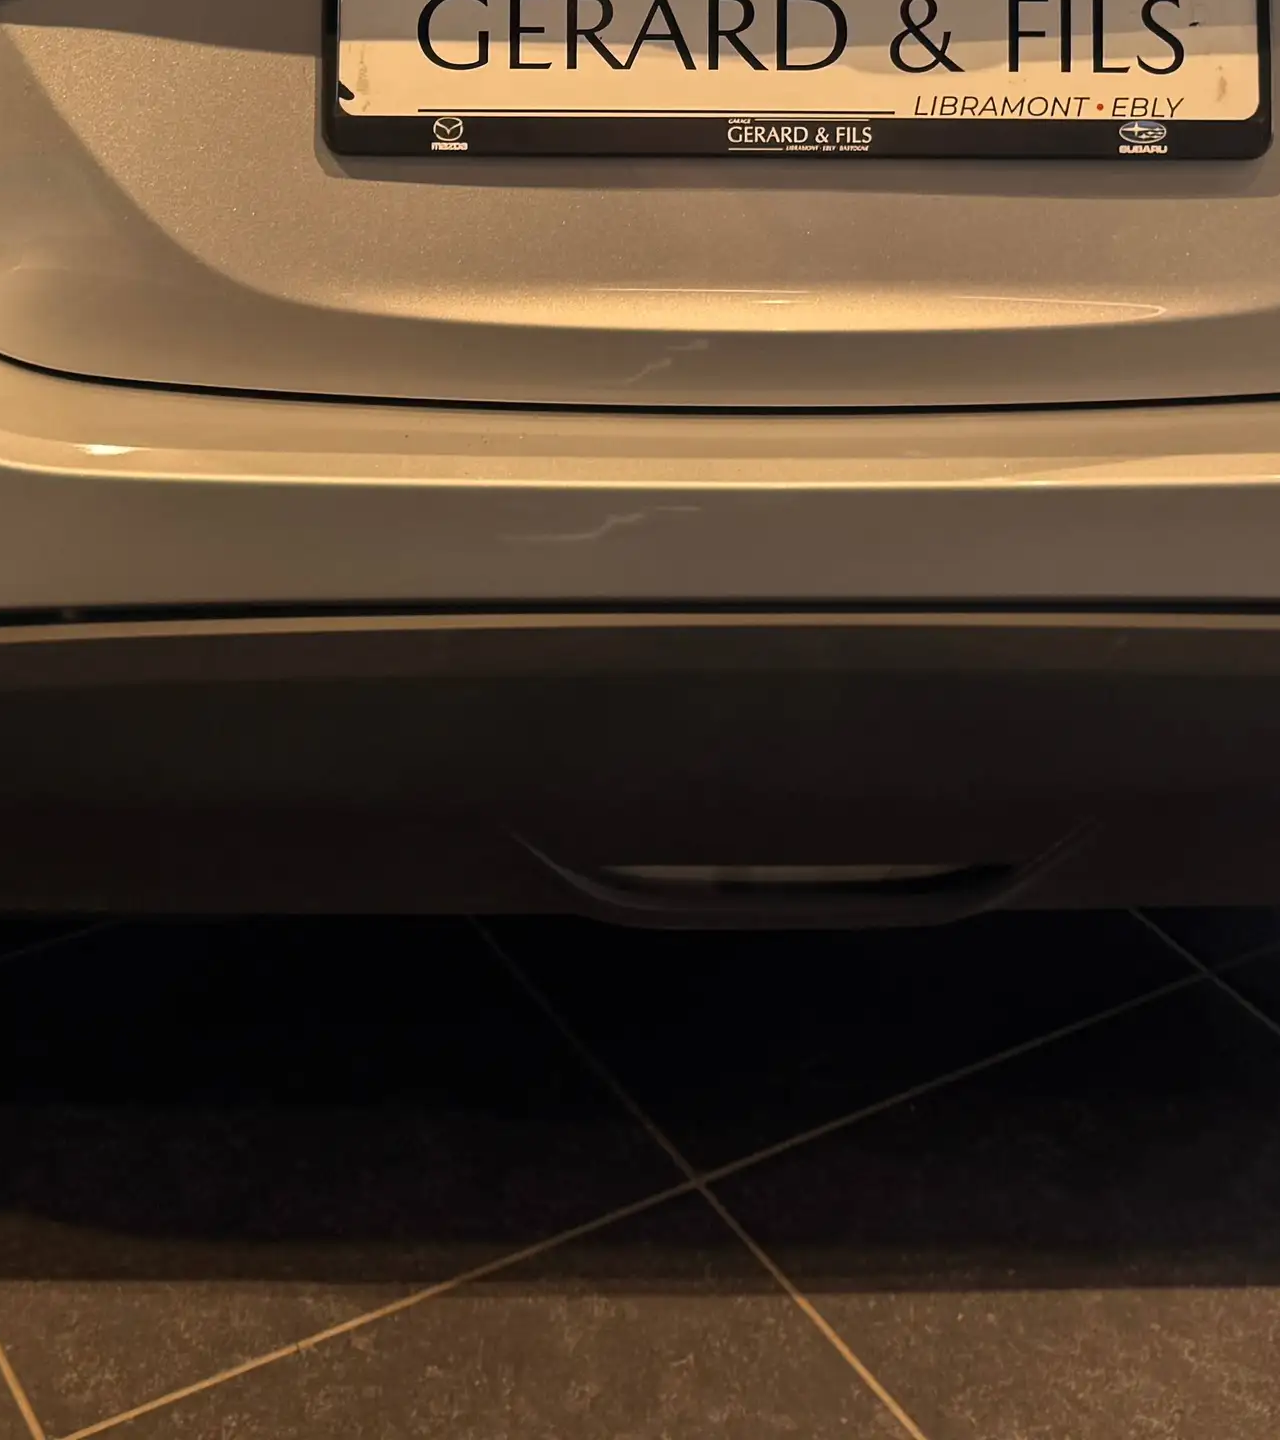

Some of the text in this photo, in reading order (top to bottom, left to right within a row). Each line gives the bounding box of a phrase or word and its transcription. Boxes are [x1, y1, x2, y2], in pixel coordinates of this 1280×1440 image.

[912, 94, 1184, 118] LIBRAMONT EBLY
[727, 126, 873, 144] GERARD & FILS
[1118, 145, 1169, 154] SUBARU
